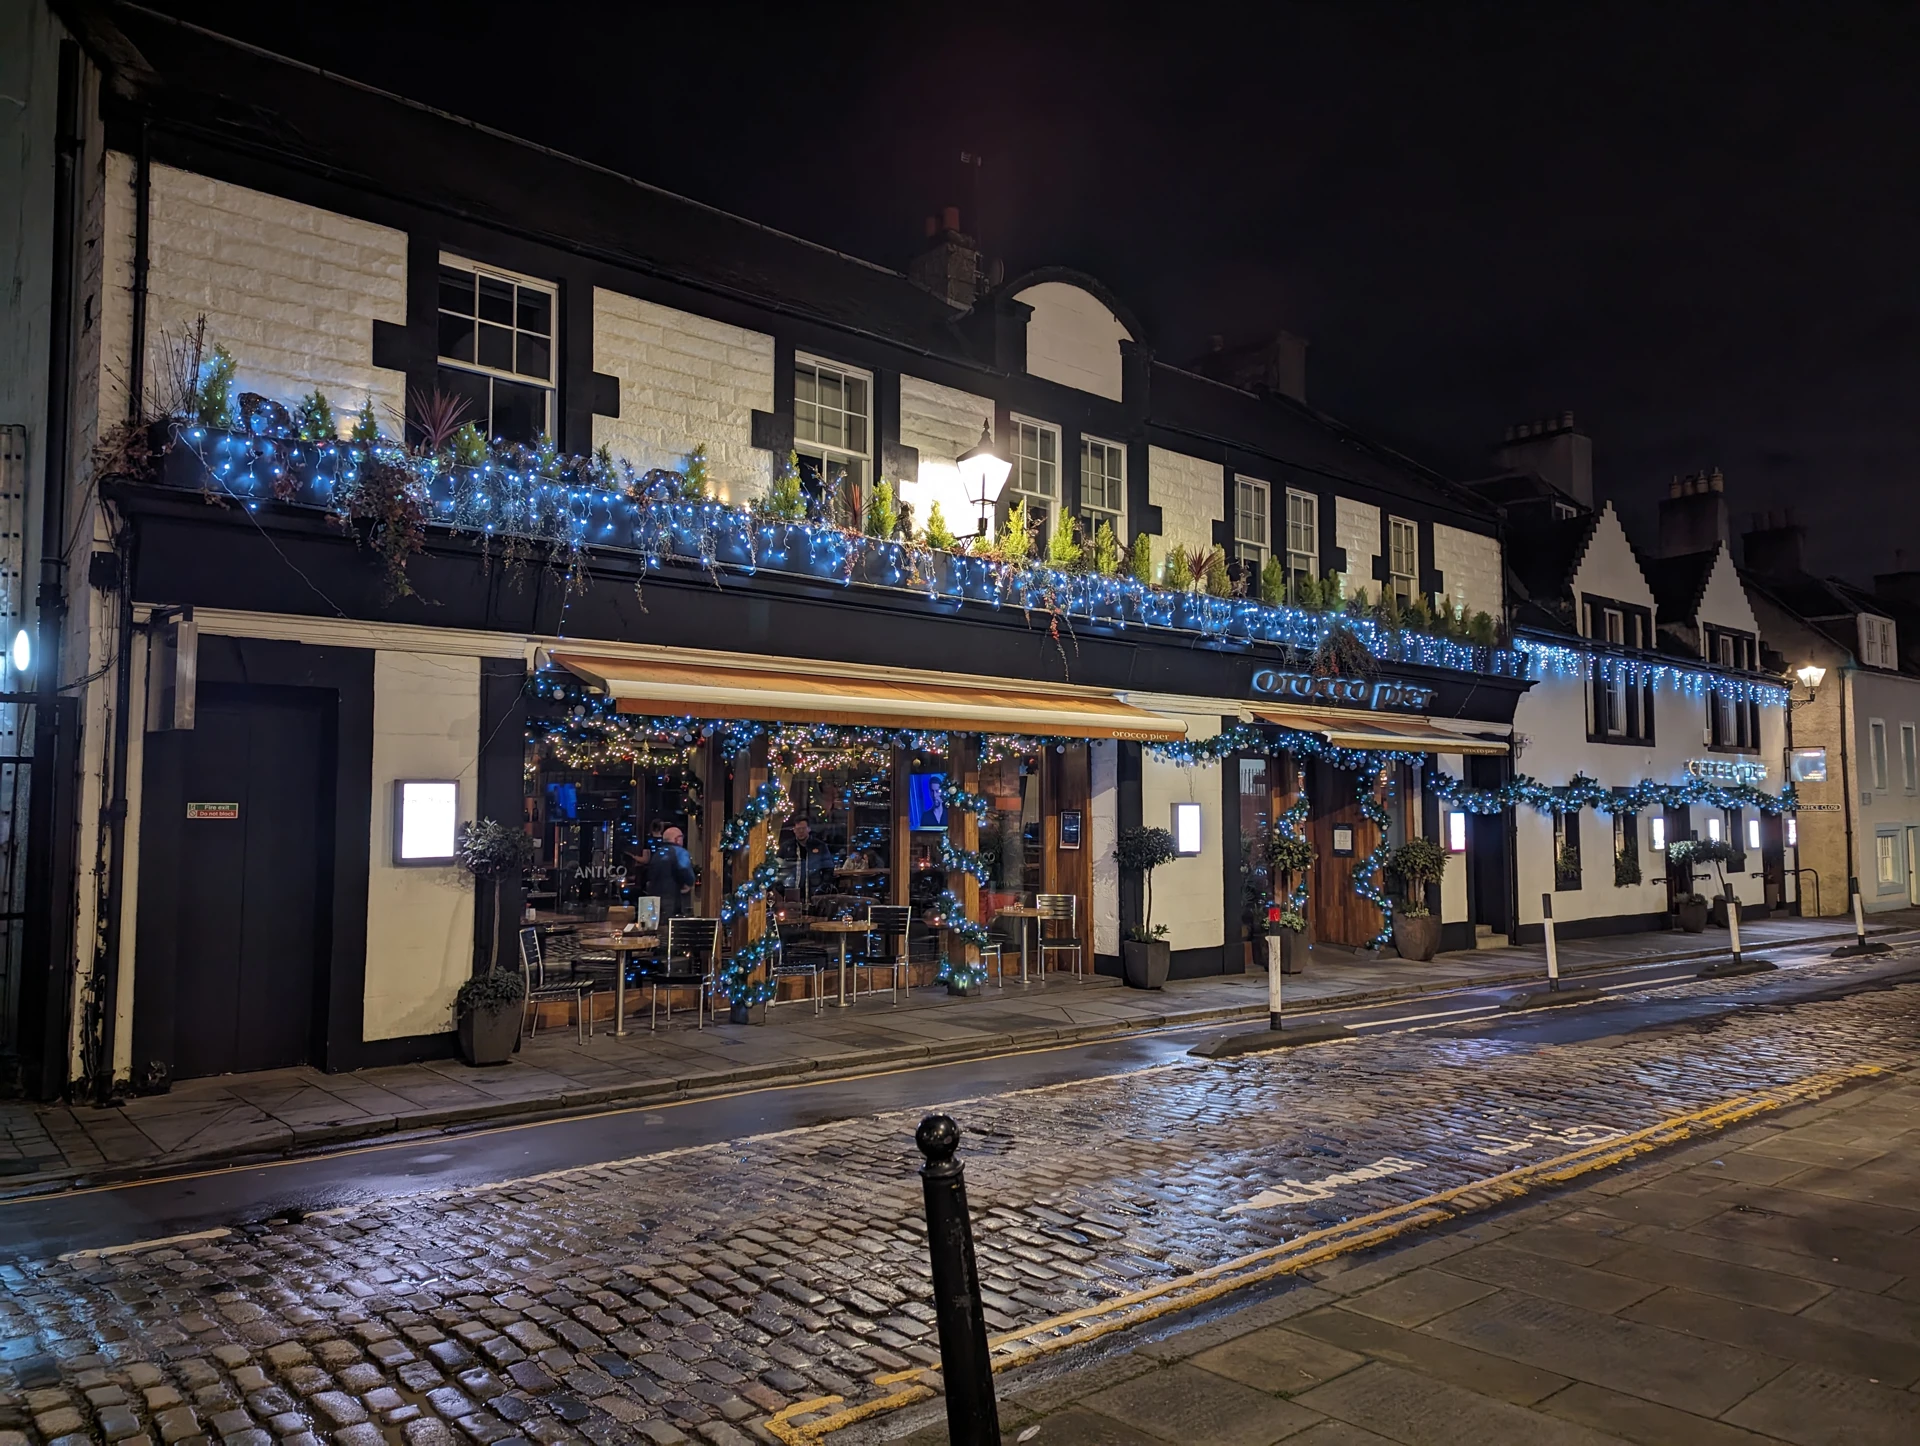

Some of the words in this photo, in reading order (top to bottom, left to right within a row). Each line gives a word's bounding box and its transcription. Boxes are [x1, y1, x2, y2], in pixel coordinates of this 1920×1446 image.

[1252, 670, 1373, 701] orocco
[1370, 680, 1439, 710] pier
[1112, 730, 1148, 739] orocco
[1150, 732, 1170, 741] pier
[574, 865, 628, 879] ANTICO
